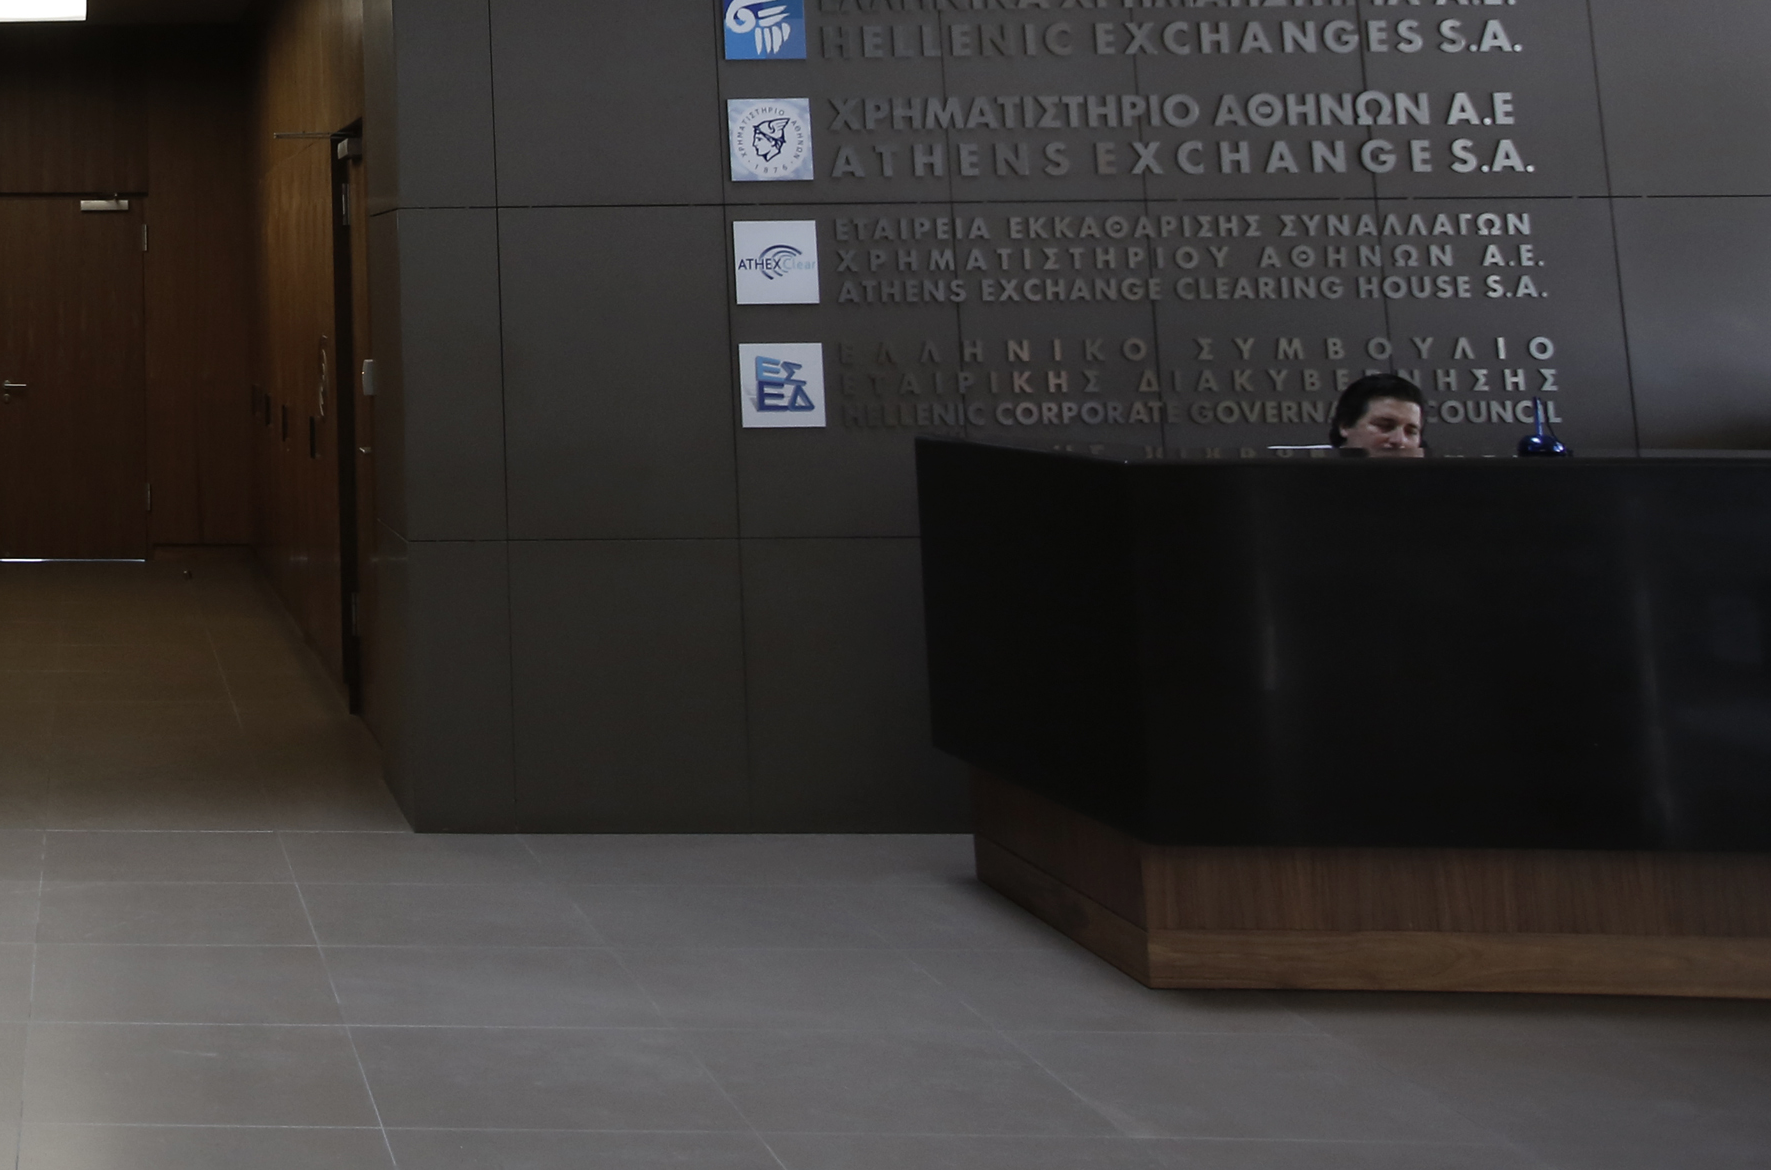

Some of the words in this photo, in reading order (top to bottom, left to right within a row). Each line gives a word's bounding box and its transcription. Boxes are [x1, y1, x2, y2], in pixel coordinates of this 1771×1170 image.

[820, 21, 1075, 59] HELLENIC
[1093, 19, 1424, 56] EXCHANGES
[1439, 18, 1523, 53] S.A.
[829, 94, 1200, 130] ΧΡΗΜΑΤΙΣΤΗΡΙΟ
[1214, 91, 1430, 127] ΑΘΗΝΩΝ
[831, 142, 1071, 177] ATHENS
[1095, 139, 1434, 175] EXCHANGE
[1450, 138, 1535, 174] S.A.
[835, 216, 990, 242] ΕΤΑΙΡΕΙΑ
[1009, 213, 1263, 240] ΕΚΚΑΘΑΡΙΣΗΣ
[1280, 212, 1532, 237] ΣΥΝΑΛΛΑΓΩΝ
[836, 245, 1228, 273] ΧΡΗΜΑΤΙΣΤΗΡΙΟΥ
[1259, 244, 1453, 270] ΑΘΗΝΩΝ
[838, 278, 967, 304] ATHENS
[981, 277, 1162, 303] EXCHANGE
[1176, 276, 1345, 301] CLEARING
[1357, 275, 1472, 300] HOUSE
[1485, 274, 1548, 298] S.A.
[839, 338, 1147, 365] ΕΛΛΗΝΙΚΟ
[1197, 336, 1555, 362] ΣΥΜΒΟΥΛΙΟ
[841, 370, 1102, 397] ΕΤΑΙΡΙΚΗΣ
[1138, 367, 1559, 394] ΔΙΑΚΥΒΕΝΗΣΗΣ
[842, 402, 986, 428] HELLENIC
[996, 401, 1180, 426] CORPORATE
